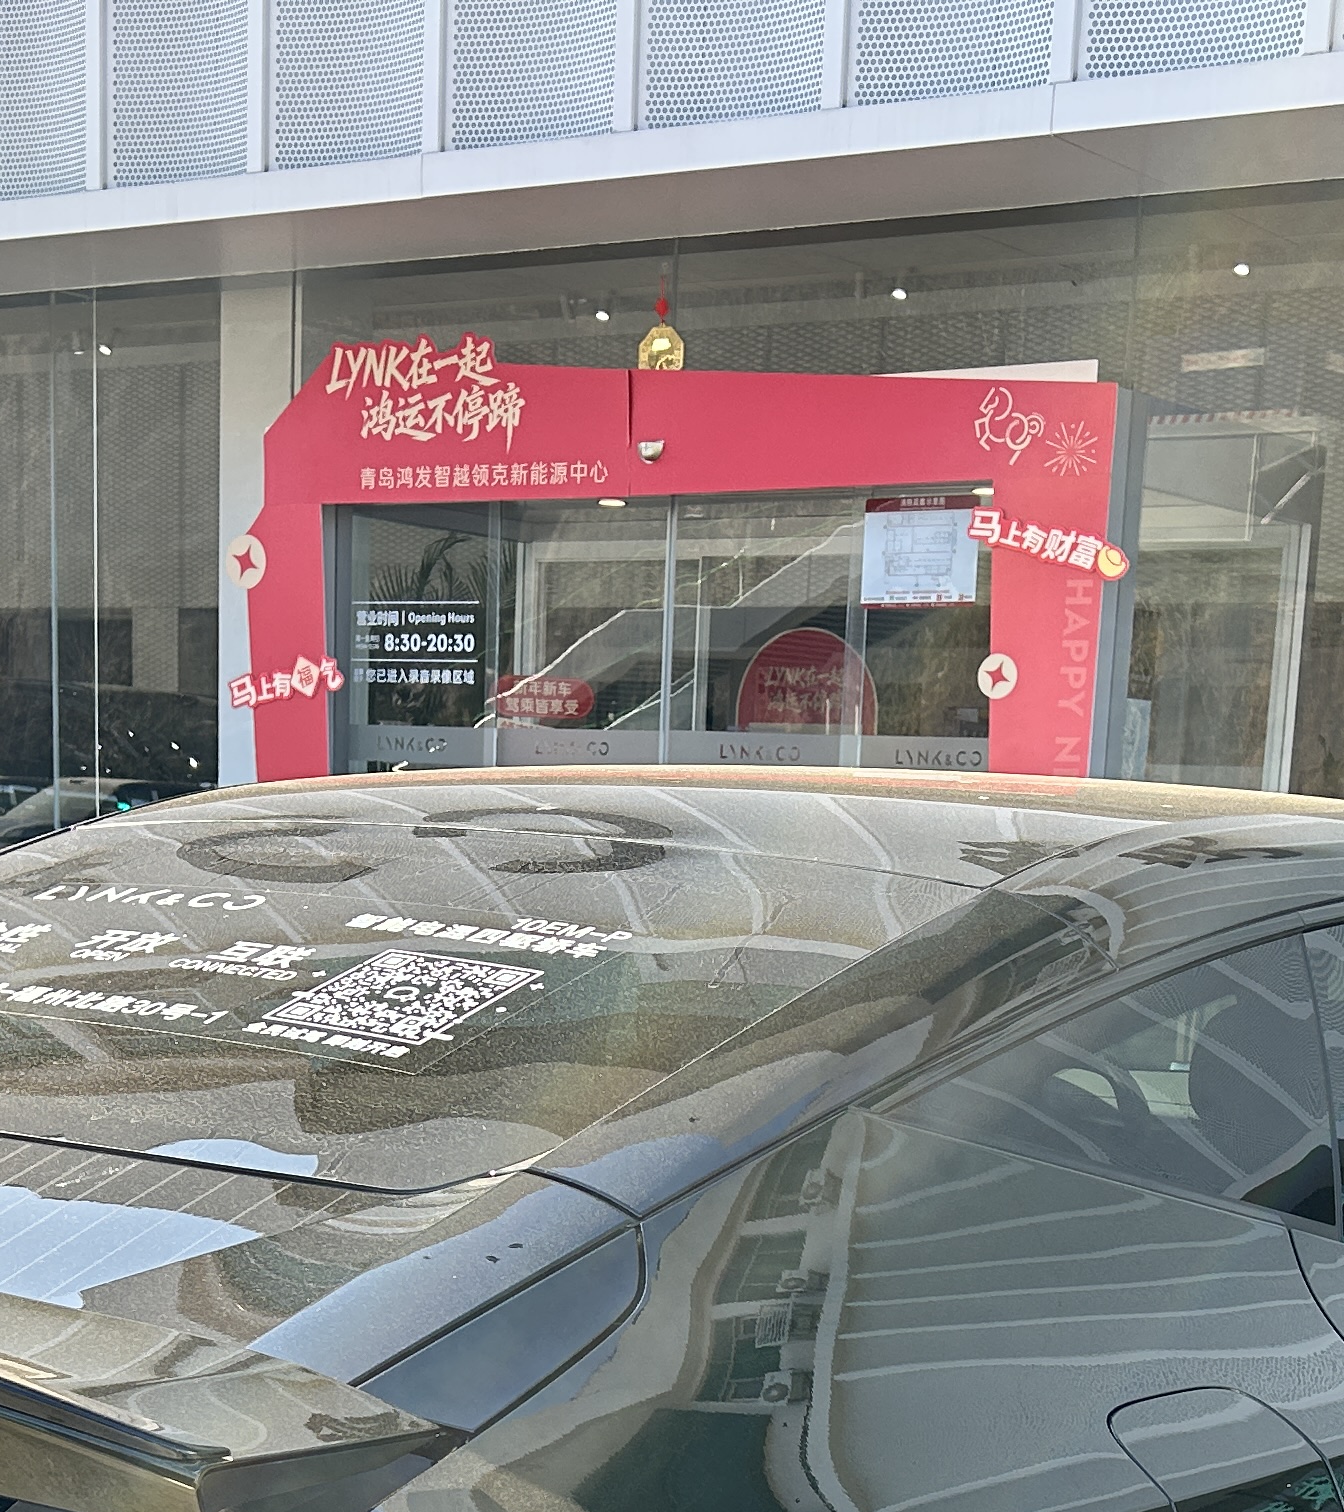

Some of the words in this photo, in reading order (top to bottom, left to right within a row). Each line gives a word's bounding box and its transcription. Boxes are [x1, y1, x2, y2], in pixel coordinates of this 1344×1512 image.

[359, 382, 526, 455] 鸿运不停蹄
[359, 459, 609, 491] 青岛鸿发智越领克新能源中心
[969, 510, 1102, 571] 马上有财富
[407, 611, 446, 626] Opening
[447, 611, 475, 624] Hours
[383, 632, 476, 653] 8:30-20:30
[1057, 578, 1094, 718] HAPPY
[895, 749, 983, 767] LYNK&CO
[1053, 736, 1081, 777] N
[33, 885, 267, 911] LYNK&CO
[69, 948, 132, 962] OPEN
[206, 940, 317, 968] 互联
[168, 958, 298, 981] CONNECTED
